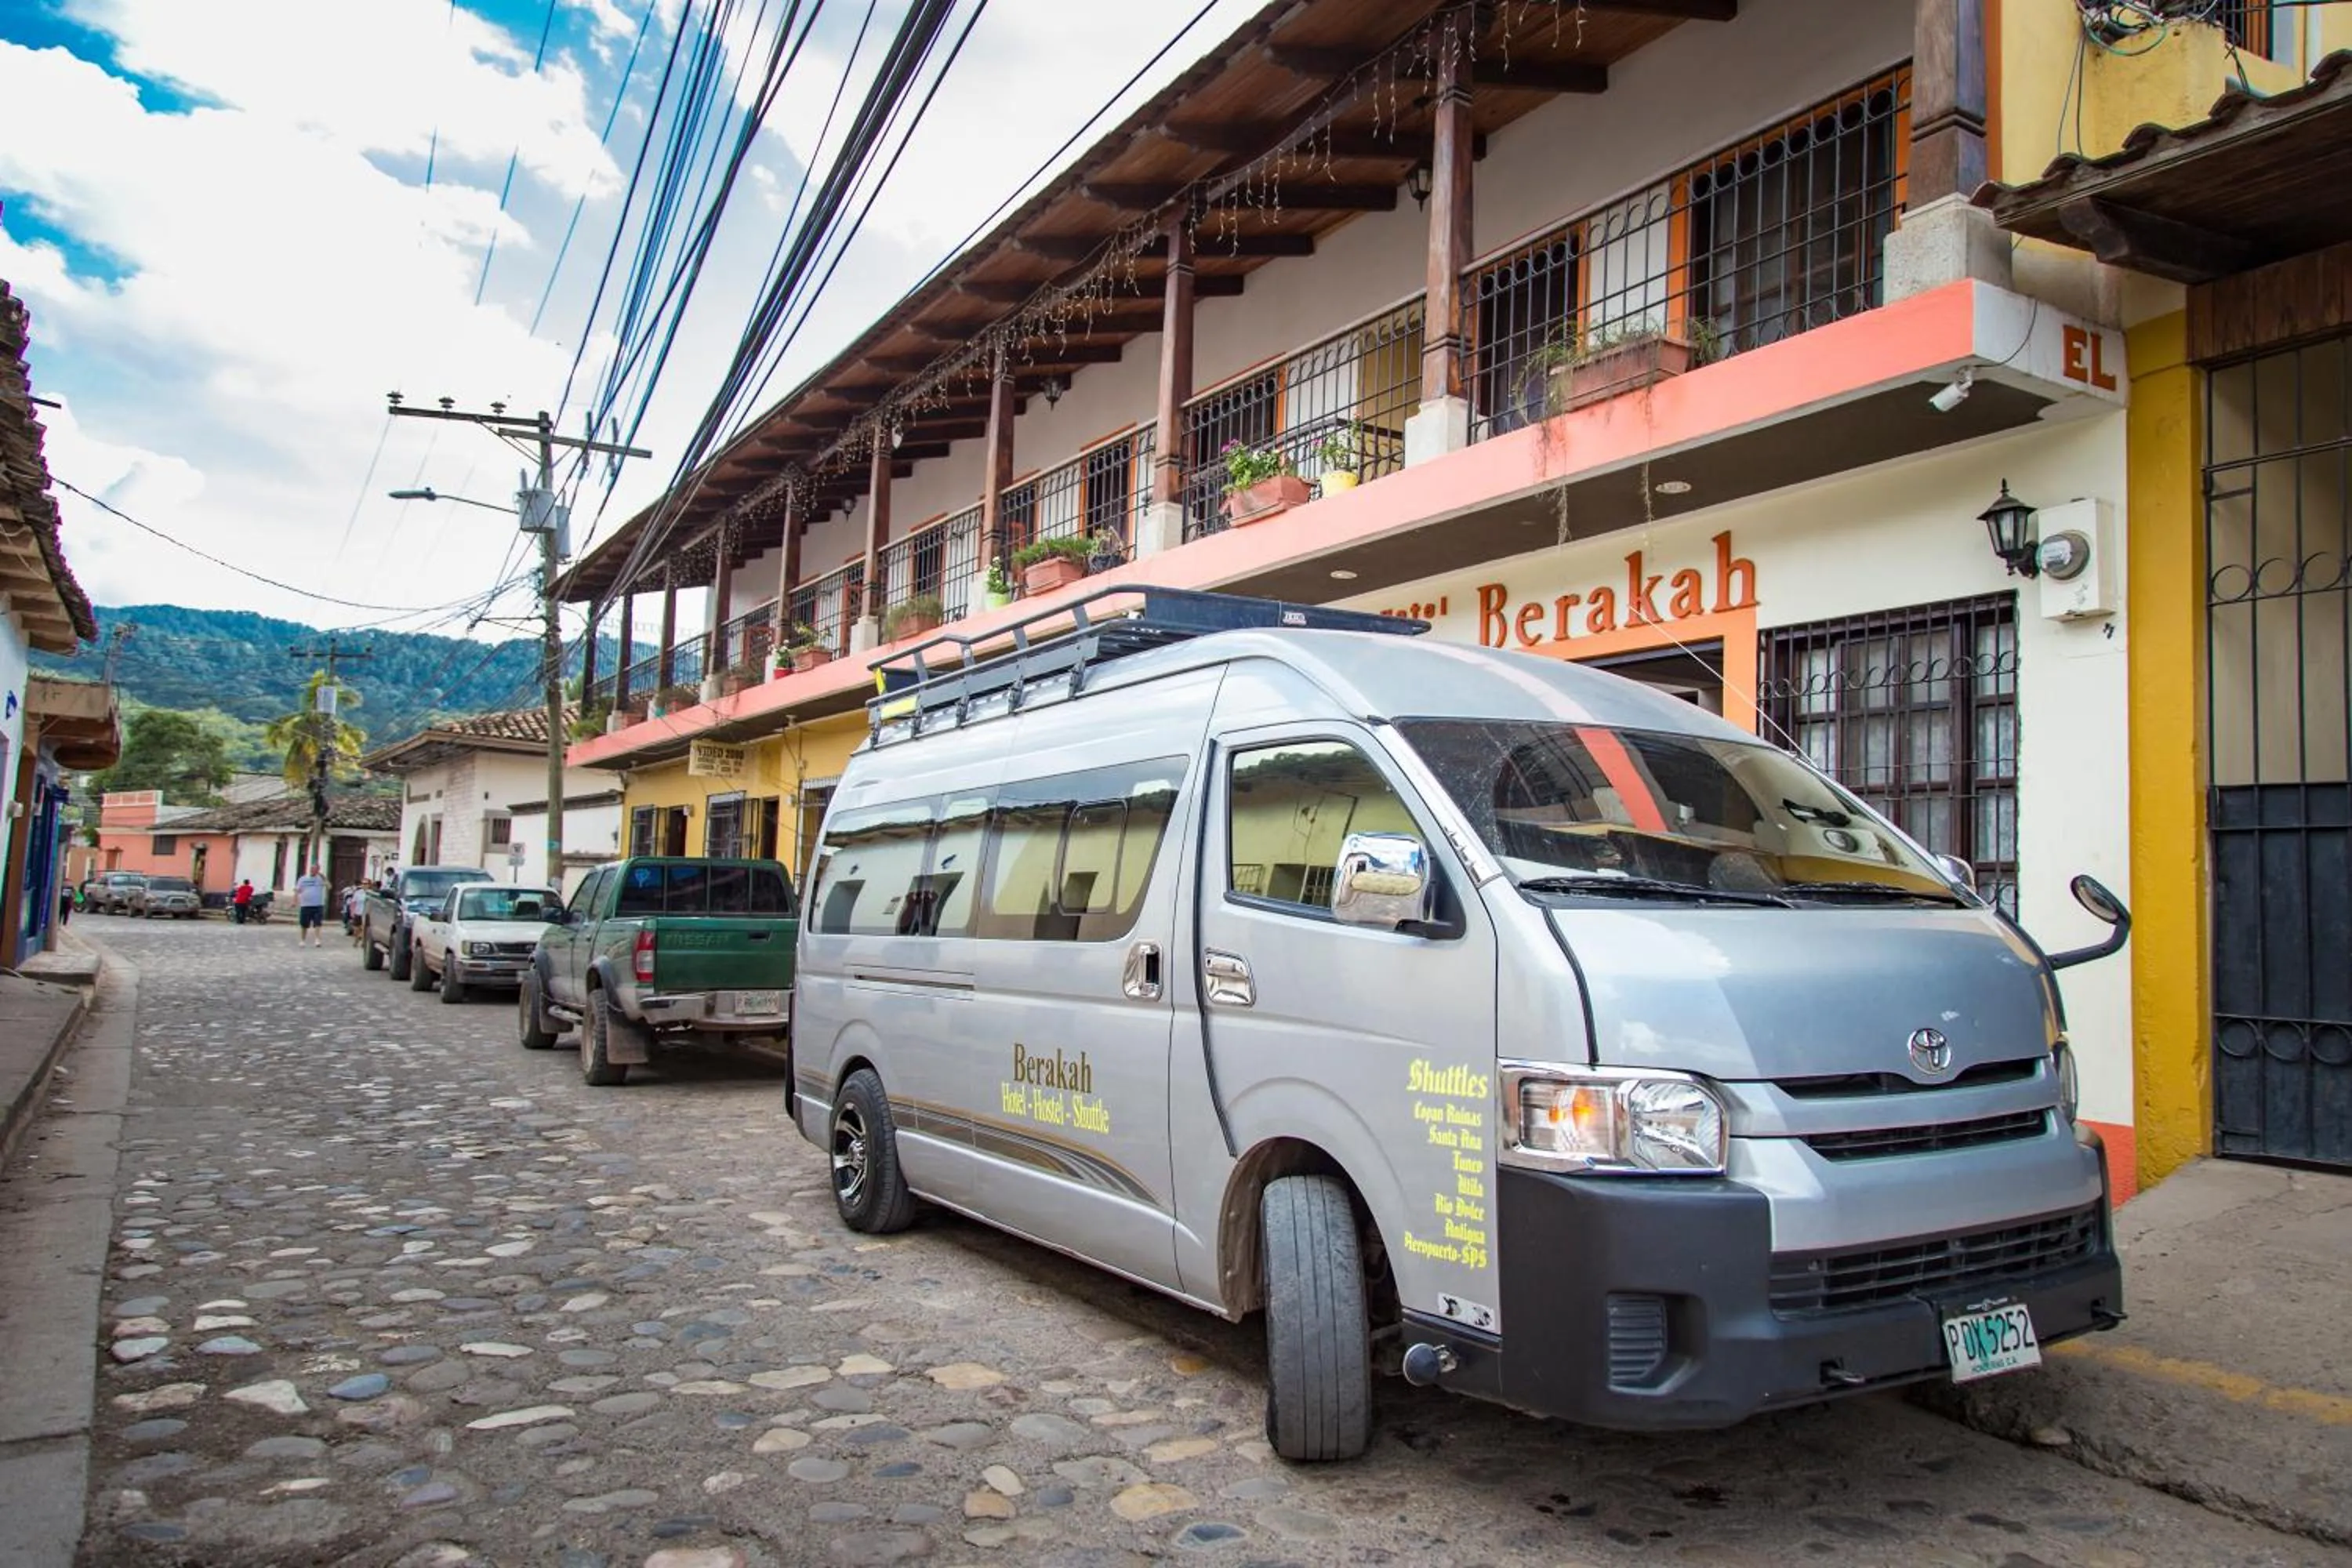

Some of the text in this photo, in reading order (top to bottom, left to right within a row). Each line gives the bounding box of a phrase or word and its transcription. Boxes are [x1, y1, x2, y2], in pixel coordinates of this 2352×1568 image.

[2063, 324, 2116, 391] EL
[1477, 530, 1762, 648] Berakah
[1014, 1043, 1092, 1094] Berakah
[1406, 1058, 1488, 1098] Shuttles
[1002, 1082, 1026, 1116] Hotel
[1033, 1087, 1064, 1126] Hostel
[1073, 1093, 1110, 1134] Shuttle
